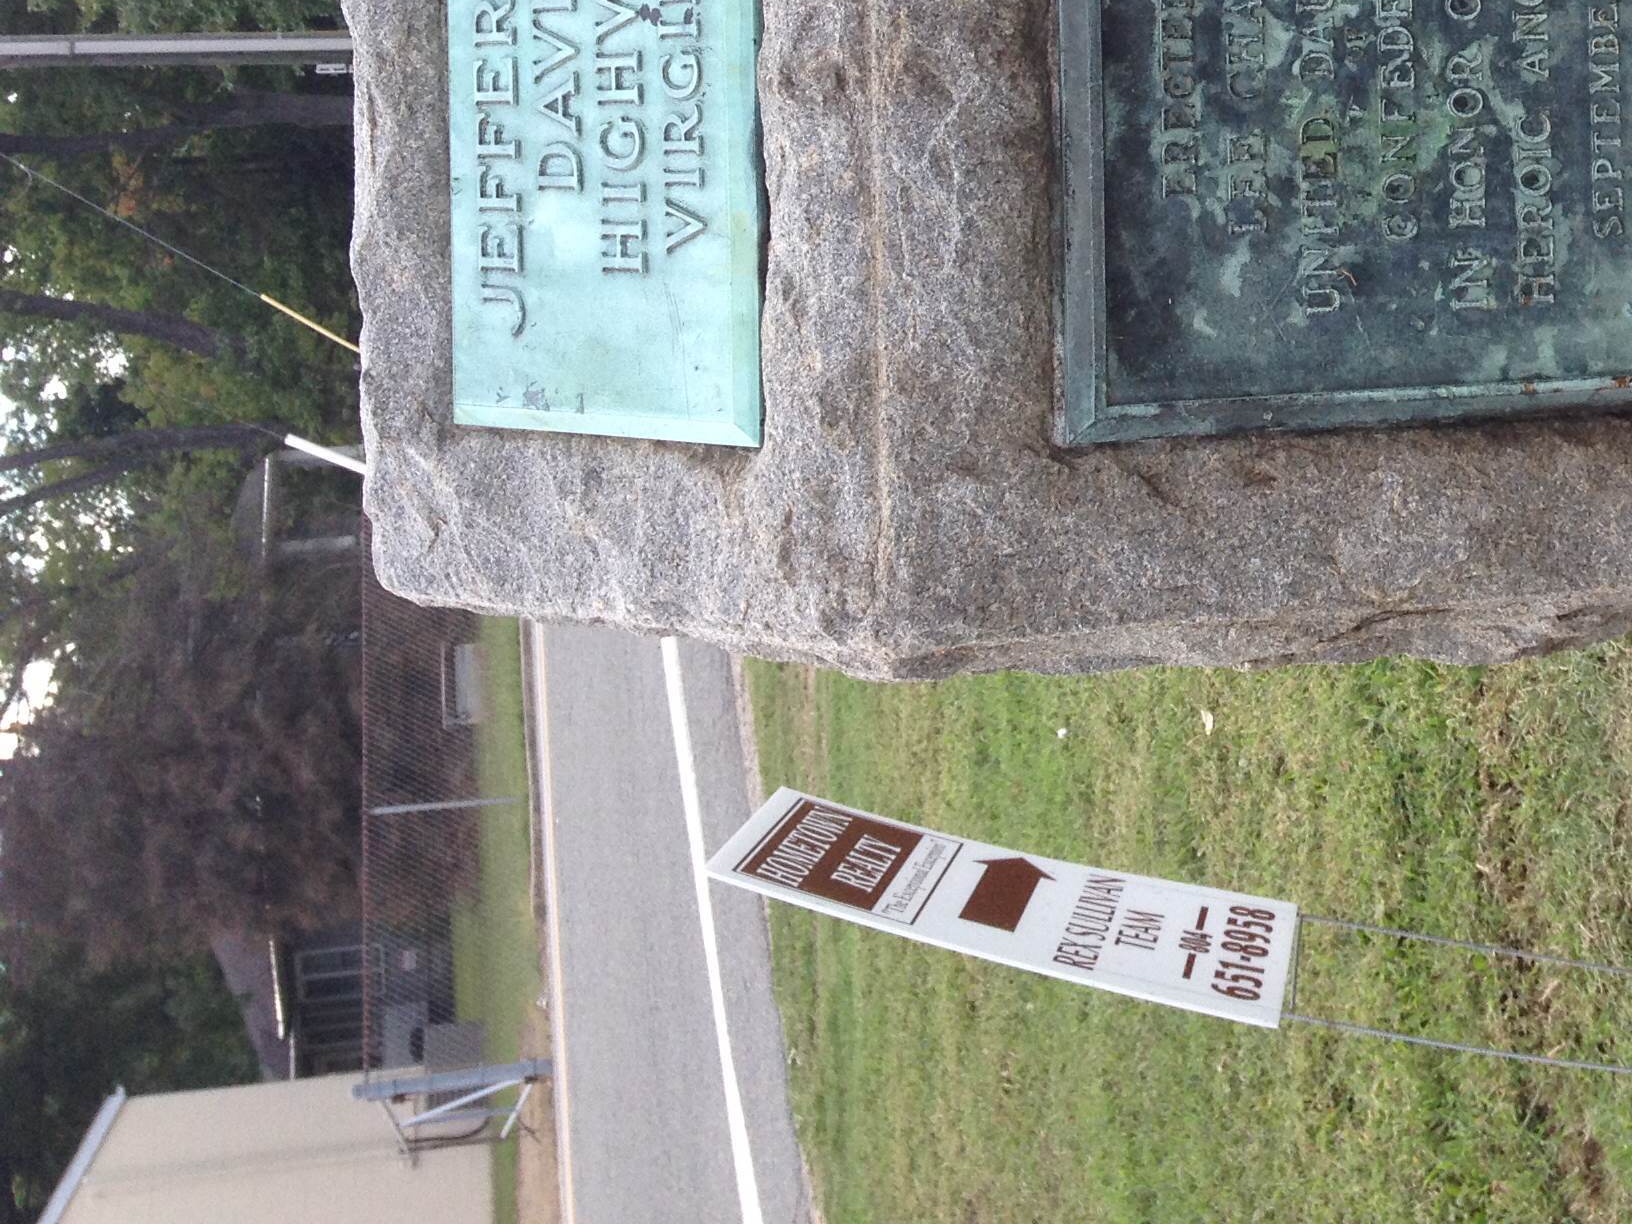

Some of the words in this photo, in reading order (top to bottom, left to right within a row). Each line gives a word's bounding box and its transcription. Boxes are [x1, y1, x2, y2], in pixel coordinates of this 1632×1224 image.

[1445, 54, 1486, 228] HONOR
[1226, 129, 1269, 235] LEE
[1298, 115, 1342, 317] UNITED
[1513, 112, 1556, 305] HEROIC
[1448, 256, 1490, 312] IN
[756, 804, 854, 888] HOMETOWN
[830, 833, 902, 893] REALTY
[1065, 873, 1126, 941] SULLIVAN
[1114, 908, 1165, 951] TEAM
[1178, 929, 1213, 954] 804
[1052, 936, 1103, 971] REX
[1210, 905, 1276, 1002] 651-8958
